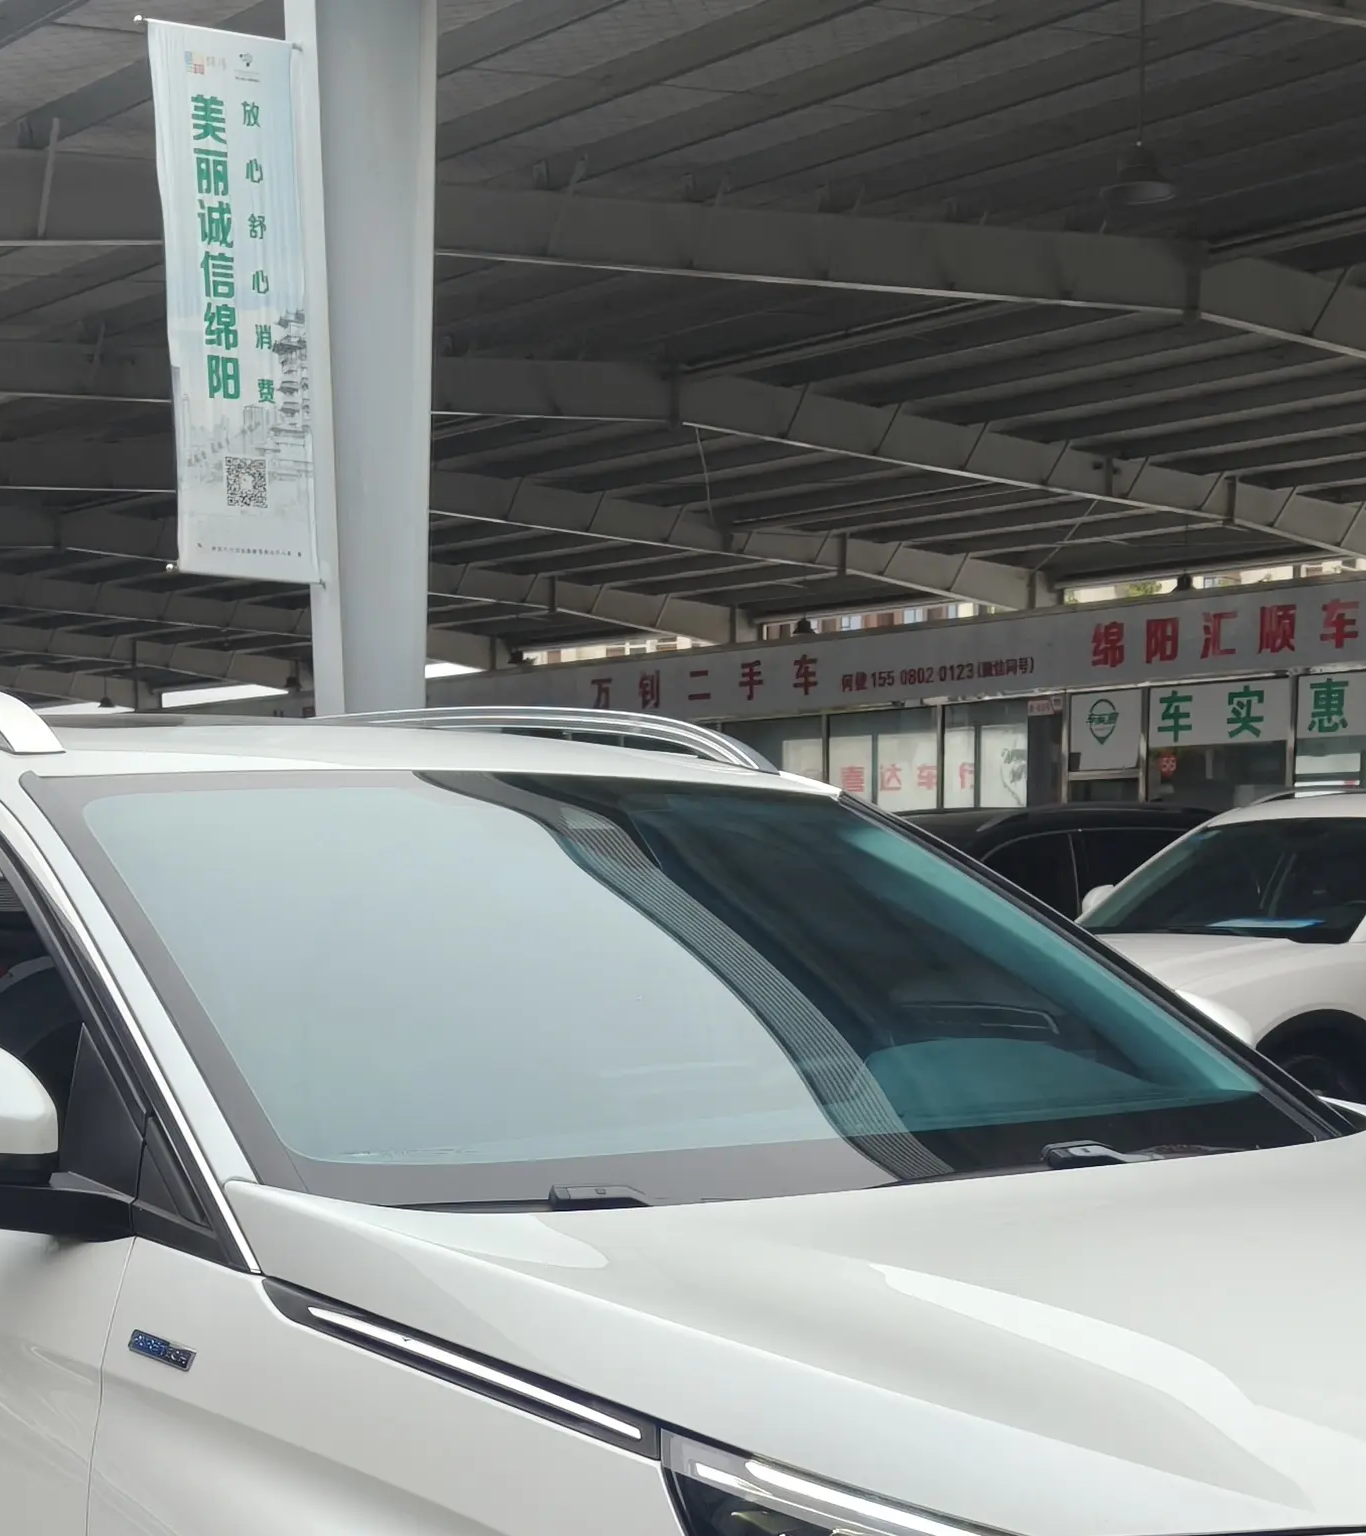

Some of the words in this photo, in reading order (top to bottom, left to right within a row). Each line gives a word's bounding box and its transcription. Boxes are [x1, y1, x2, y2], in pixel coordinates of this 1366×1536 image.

[191, 94, 241, 400] 美丽诚信绵阳
[241, 101, 276, 404] 放心舒心消费
